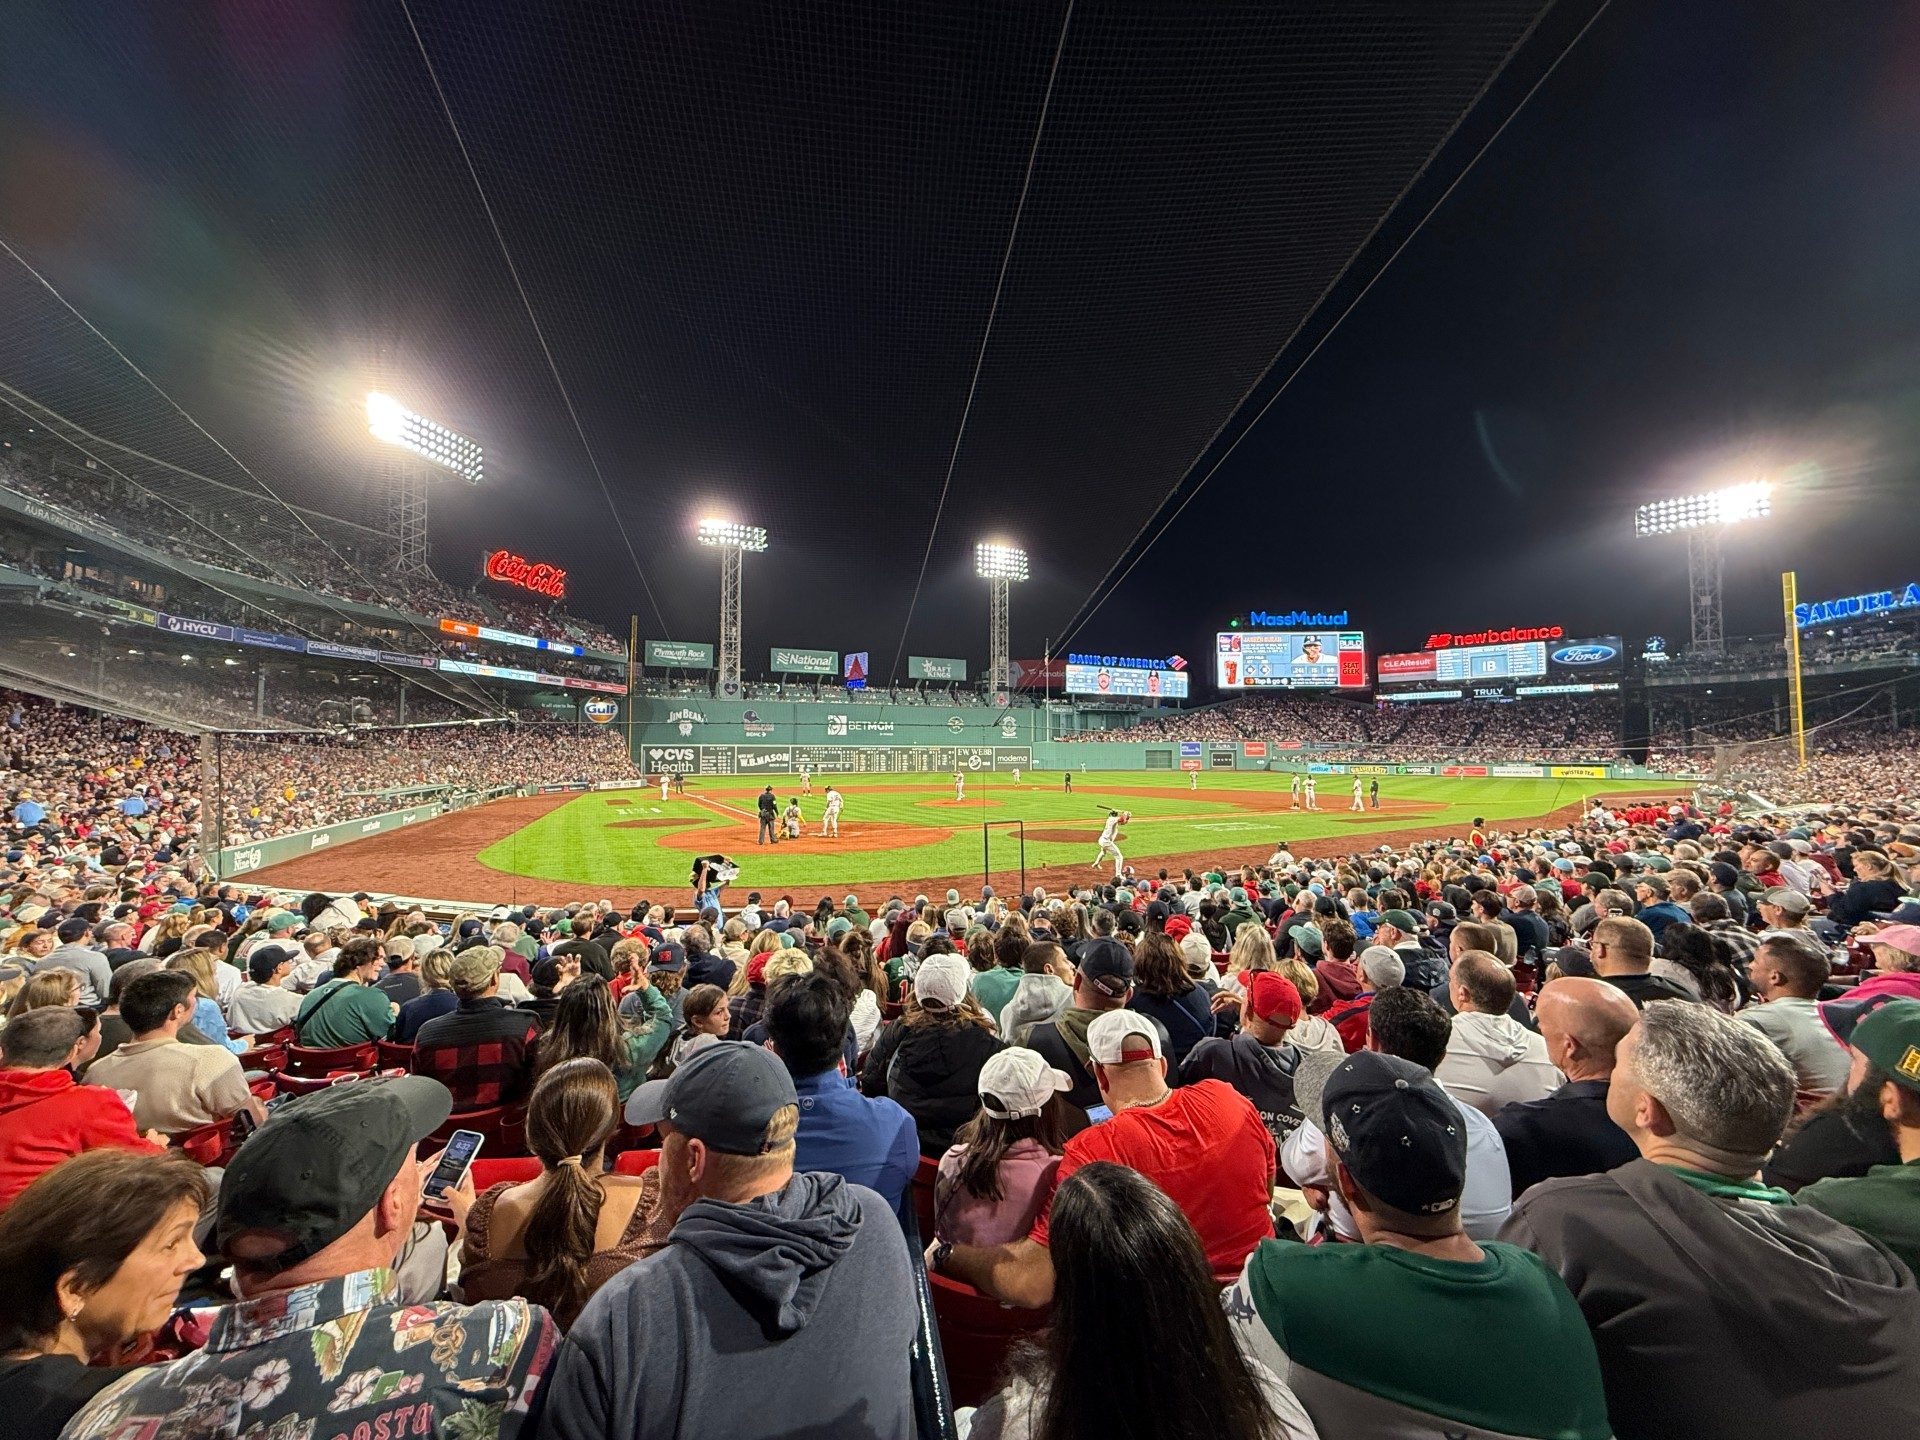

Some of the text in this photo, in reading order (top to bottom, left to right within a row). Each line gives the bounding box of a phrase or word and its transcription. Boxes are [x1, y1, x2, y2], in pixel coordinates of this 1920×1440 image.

[1794, 590, 1898, 628] SAMUEL
[1250, 610, 1348, 626] MassMutual
[182, 621, 217, 635] HYCU
[789, 654, 832, 665] National
[1564, 648, 1602, 661] Ford
[1068, 653, 1167, 669] BANK OF AMERICA
[1384, 658, 1431, 668] CLEAResult
[924, 664, 951, 673] DRAFT
[1473, 688, 1504, 696] TRULY
[586, 704, 616, 714] Gulf
[667, 710, 682, 723] JIM
[848, 720, 894, 731] BETMGM
[664, 748, 695, 760] CVS
[971, 748, 992, 756] WEBB
[997, 754, 1028, 762] moderna
[650, 760, 695, 773] Health
